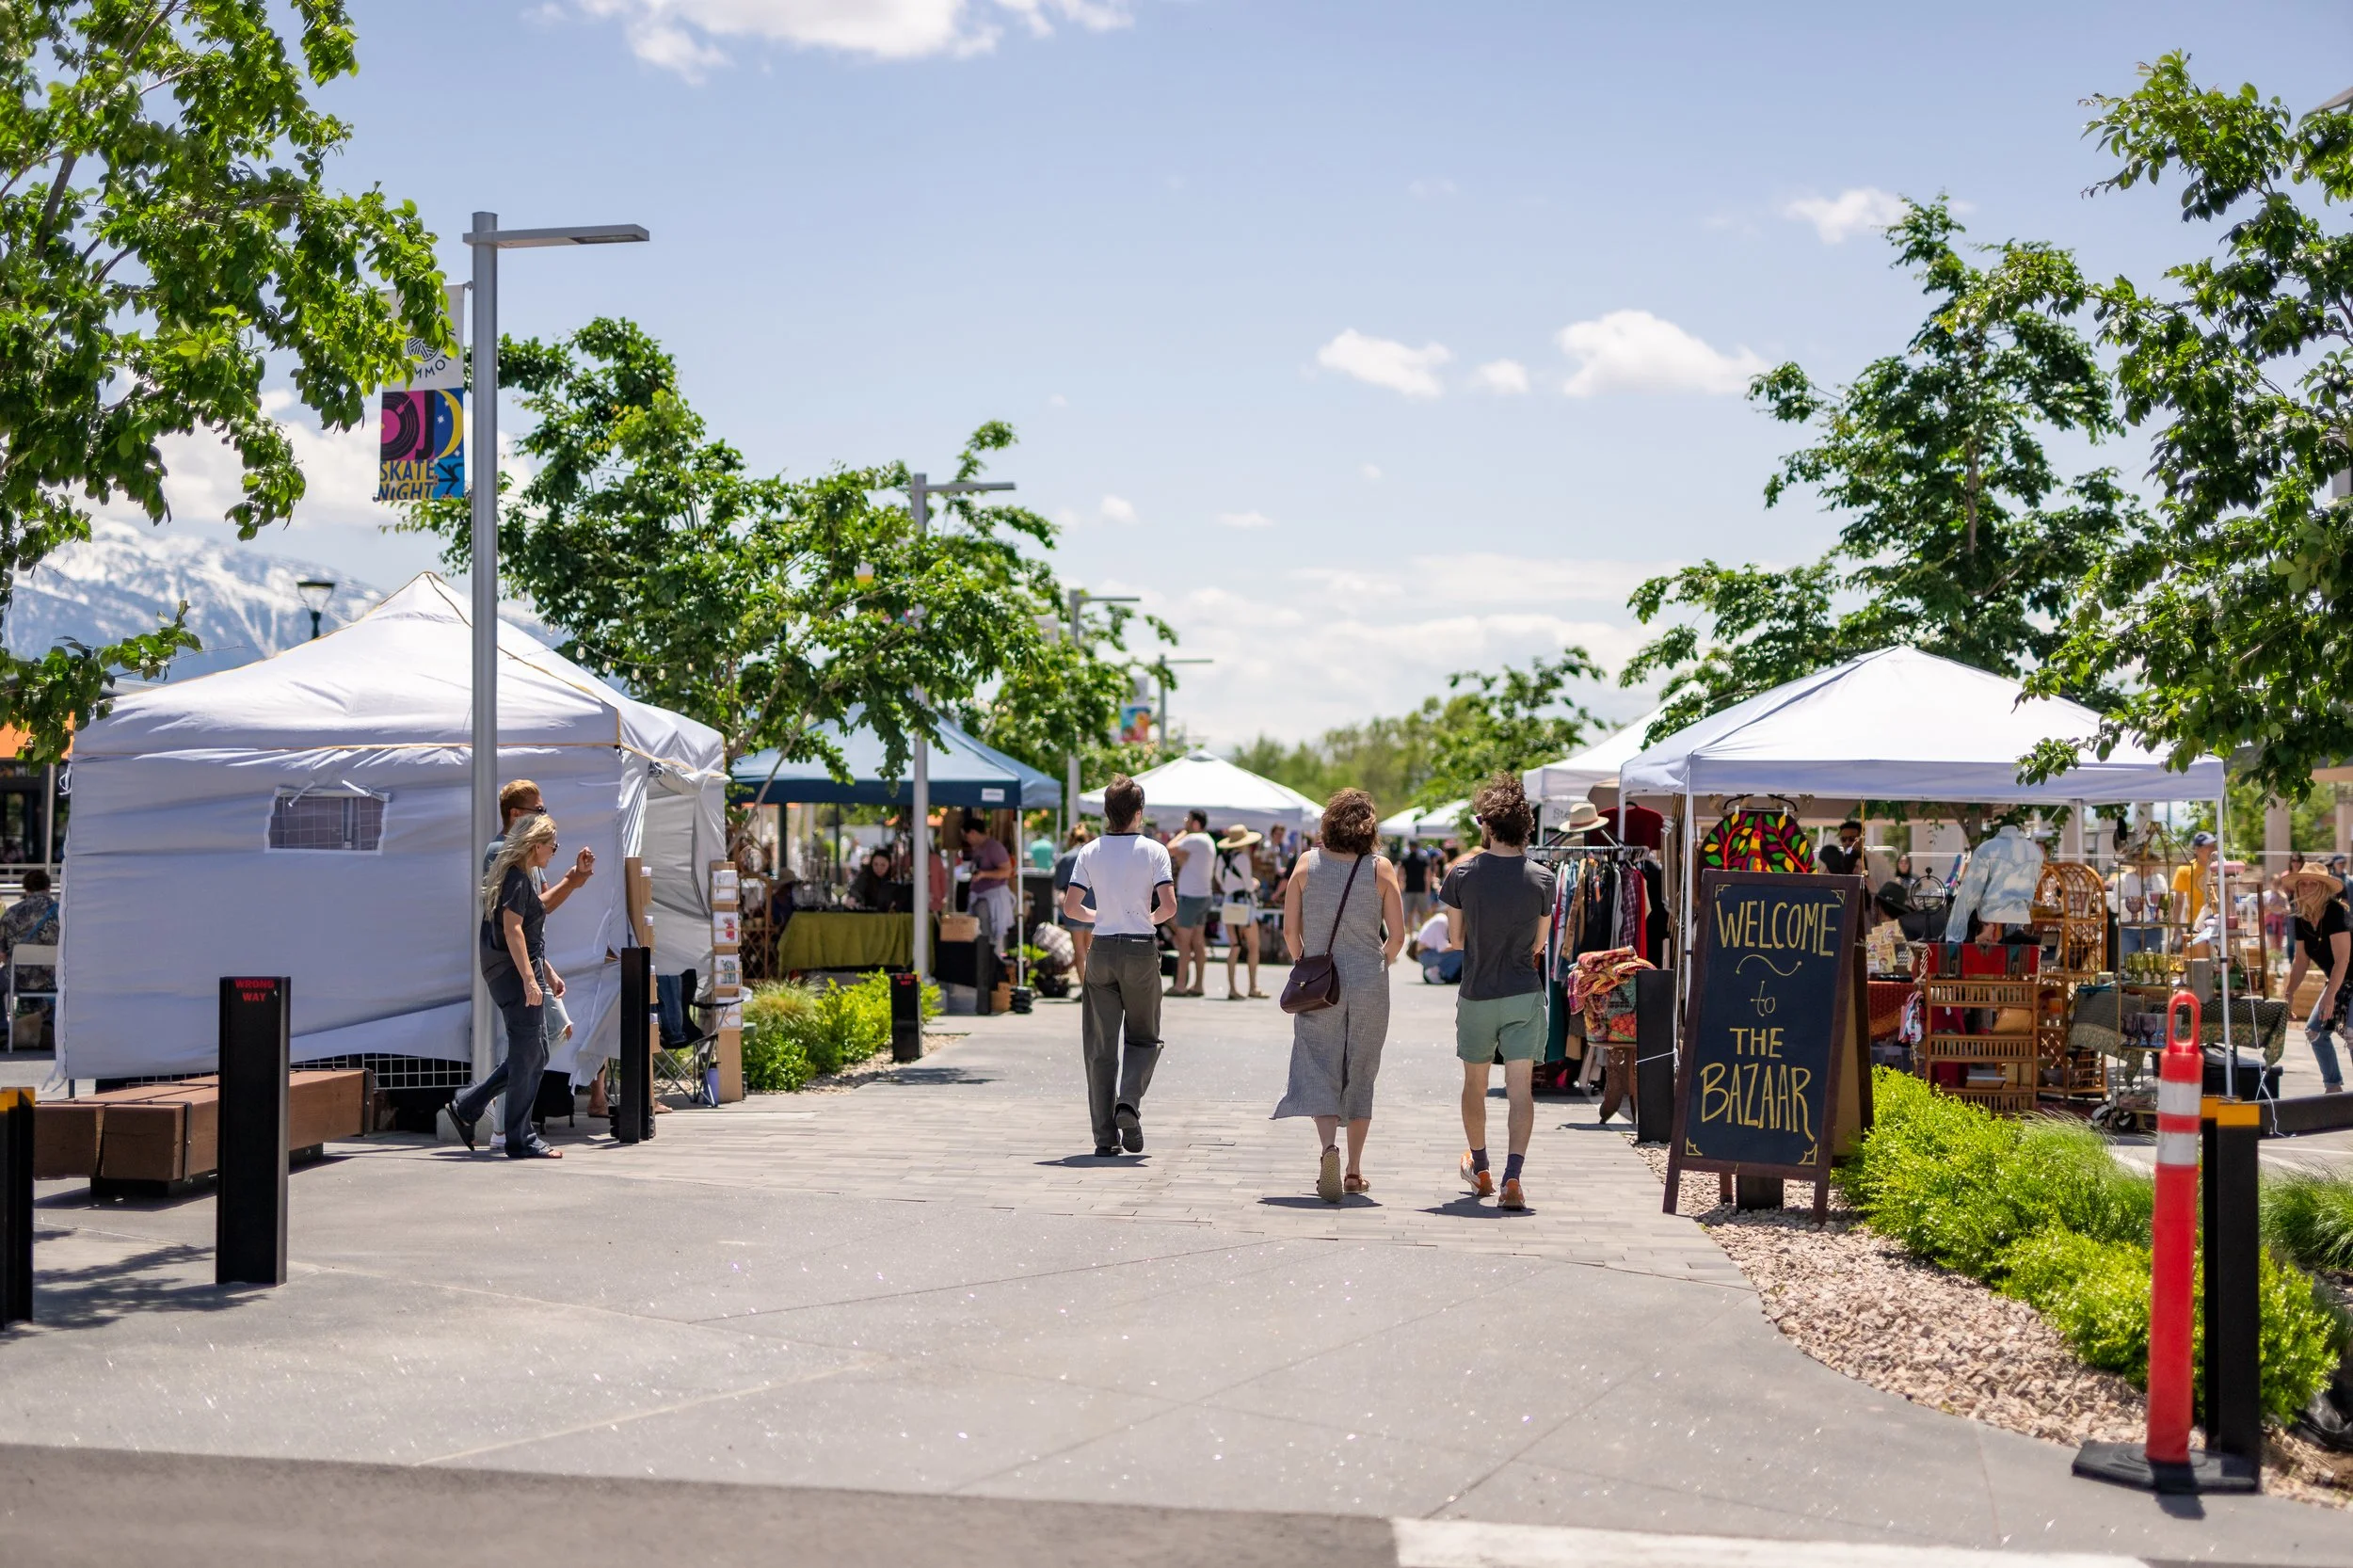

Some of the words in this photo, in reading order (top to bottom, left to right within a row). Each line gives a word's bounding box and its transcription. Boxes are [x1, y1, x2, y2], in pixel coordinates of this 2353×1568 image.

[380, 459, 435, 482] SKATE
[378, 482, 435, 501] NIGHT
[1554, 808, 1570, 820] Ste
[1715, 900, 1841, 957] WELCOME
[234, 980, 275, 988] WRONG
[242, 993, 265, 1001] WAY
[1750, 980, 1776, 1016] to
[1729, 1028, 1785, 1059] THE
[1700, 1063, 1816, 1143] BAZAAR
